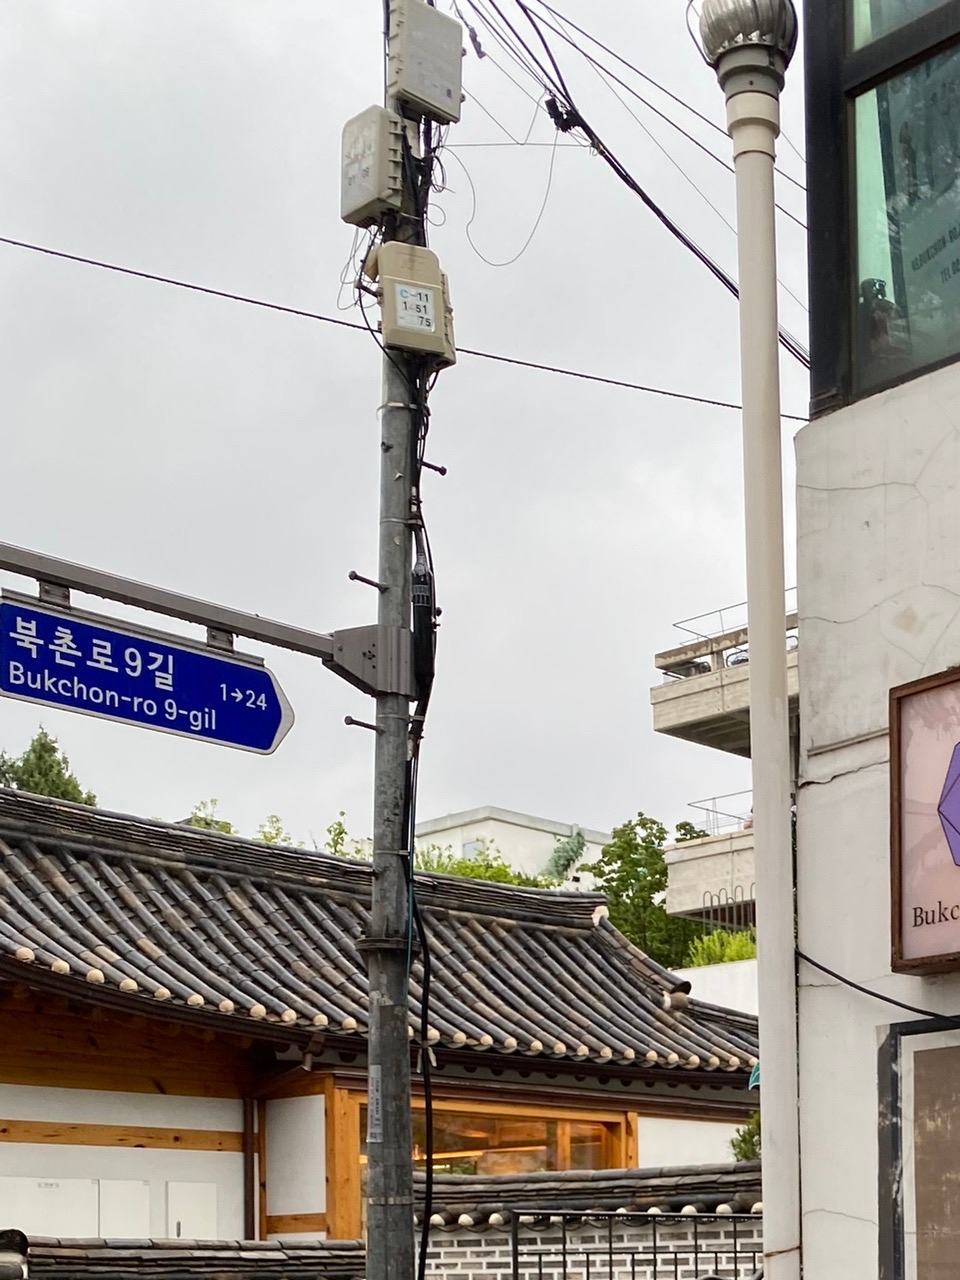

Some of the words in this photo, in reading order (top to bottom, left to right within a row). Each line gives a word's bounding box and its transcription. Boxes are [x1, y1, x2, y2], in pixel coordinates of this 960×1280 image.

[9, 616, 175, 692] 북촌로9길
[9, 661, 158, 716] Bukchon-ro
[165, 698, 216, 731] 9-gil
